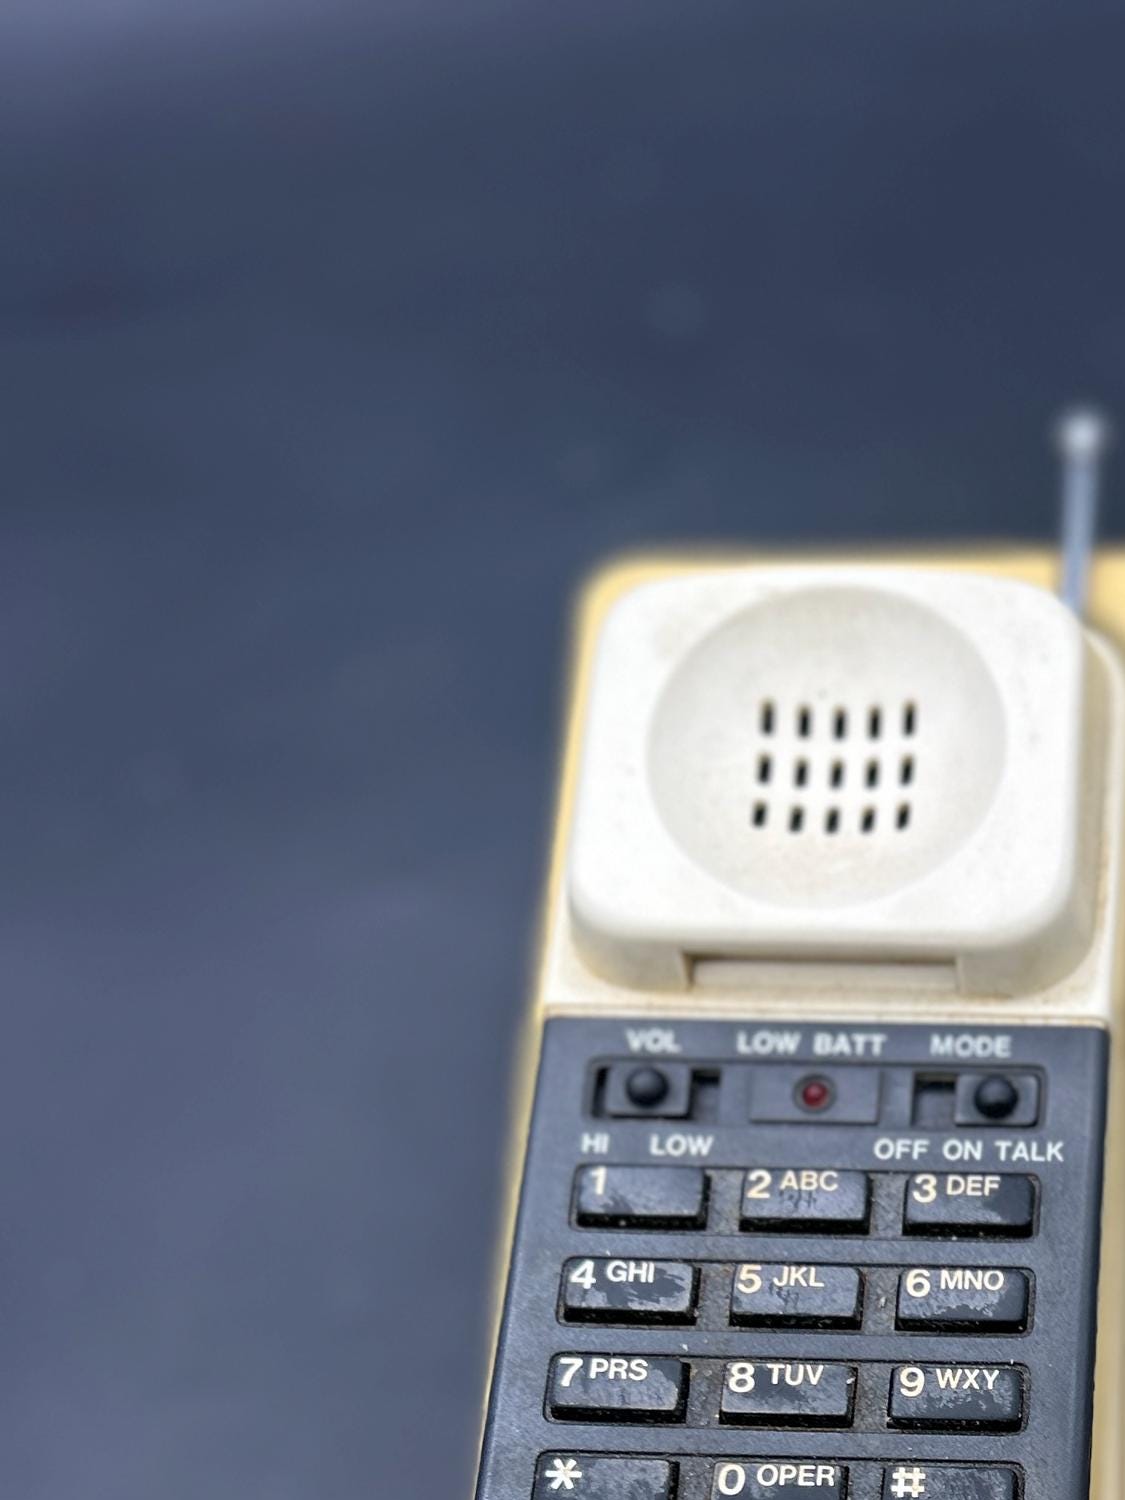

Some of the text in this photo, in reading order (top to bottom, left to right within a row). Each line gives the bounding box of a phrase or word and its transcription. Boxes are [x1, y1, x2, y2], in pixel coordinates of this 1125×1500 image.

[626, 1030, 681, 1053] VOL
[737, 1031, 887, 1056] LOW BATT
[931, 1035, 1012, 1057] MODE
[582, 1132, 713, 1157] HI LOW
[874, 1137, 1065, 1163] OFF ON TALK
[589, 1168, 606, 1196] 1
[746, 1170, 838, 1199] 2 ABC
[912, 1174, 1001, 1202] 3 DEF
[569, 1259, 655, 1290] 4 GHI
[736, 1264, 825, 1294] 5 JKL
[905, 1268, 1005, 1298] 6 MNO
[558, 1357, 648, 1387] 7 PRS
[728, 1361, 824, 1393] 8 TUV
[899, 1366, 1000, 1397] 9 WXY
[718, 1463, 836, 1496] 0 OPER
[891, 1467, 926, 1498] #
